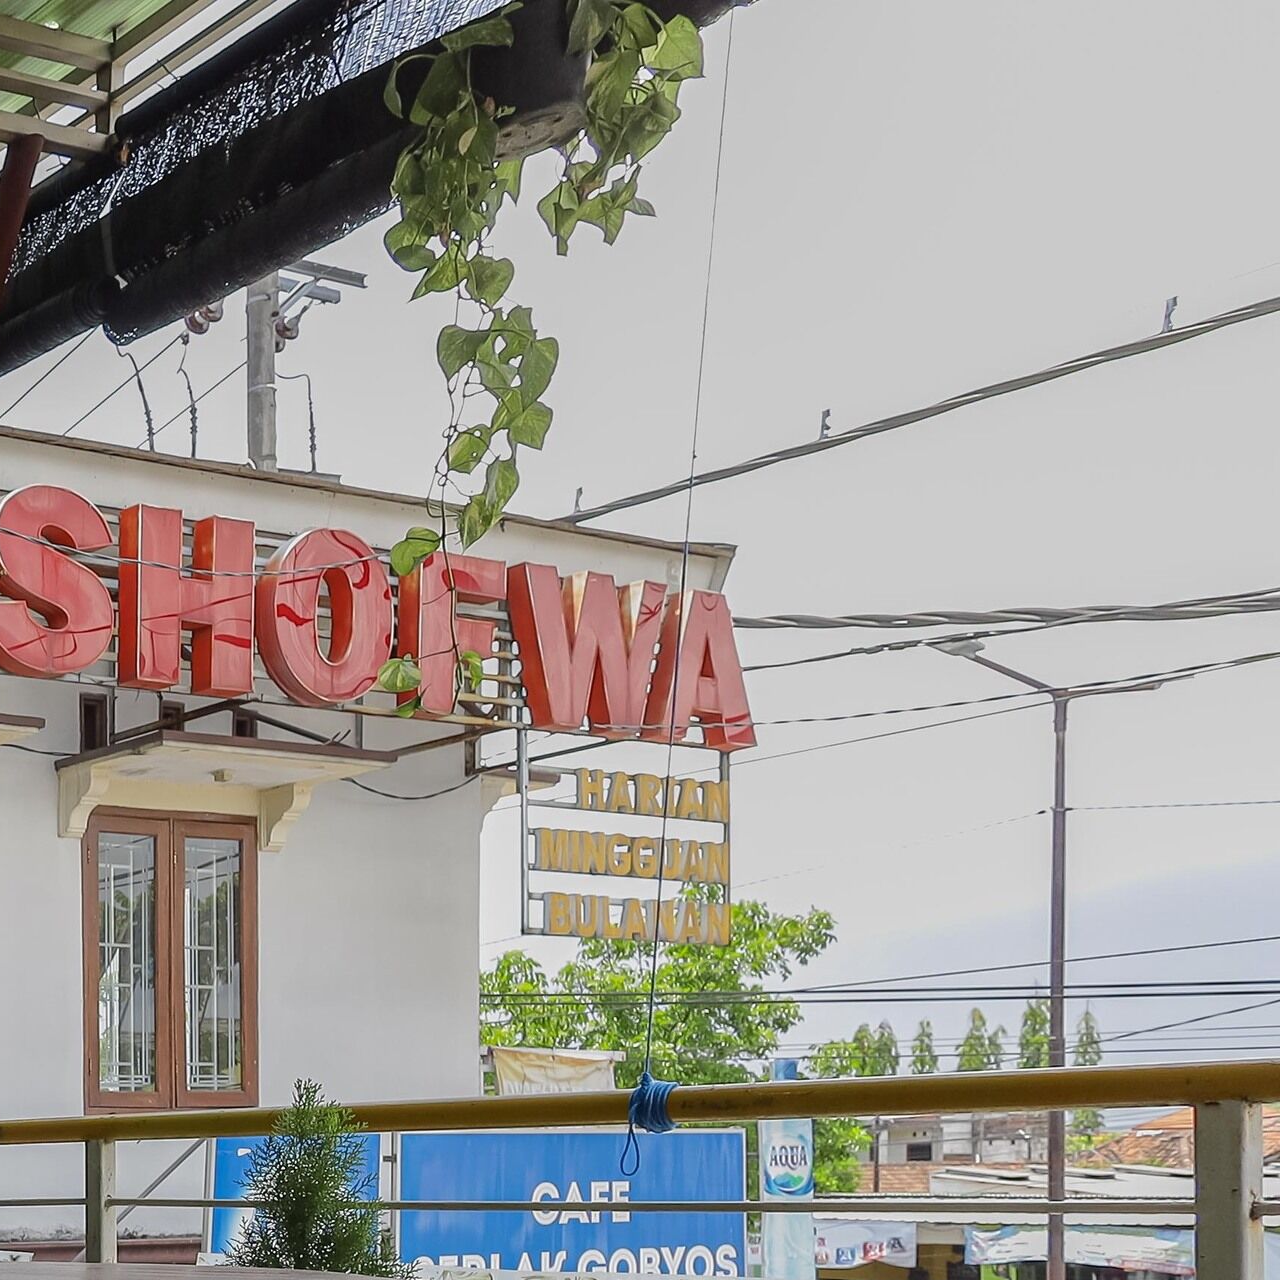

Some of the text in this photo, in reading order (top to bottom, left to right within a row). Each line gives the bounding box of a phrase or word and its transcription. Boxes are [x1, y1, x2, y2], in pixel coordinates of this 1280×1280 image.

[576, 768, 728, 822] HARIAN
[535, 828, 728, 883] MINGGUAN
[544, 892, 730, 945] BULANAN
[770, 1145, 808, 1170] AQUA
[531, 1180, 632, 1226] CAFE
